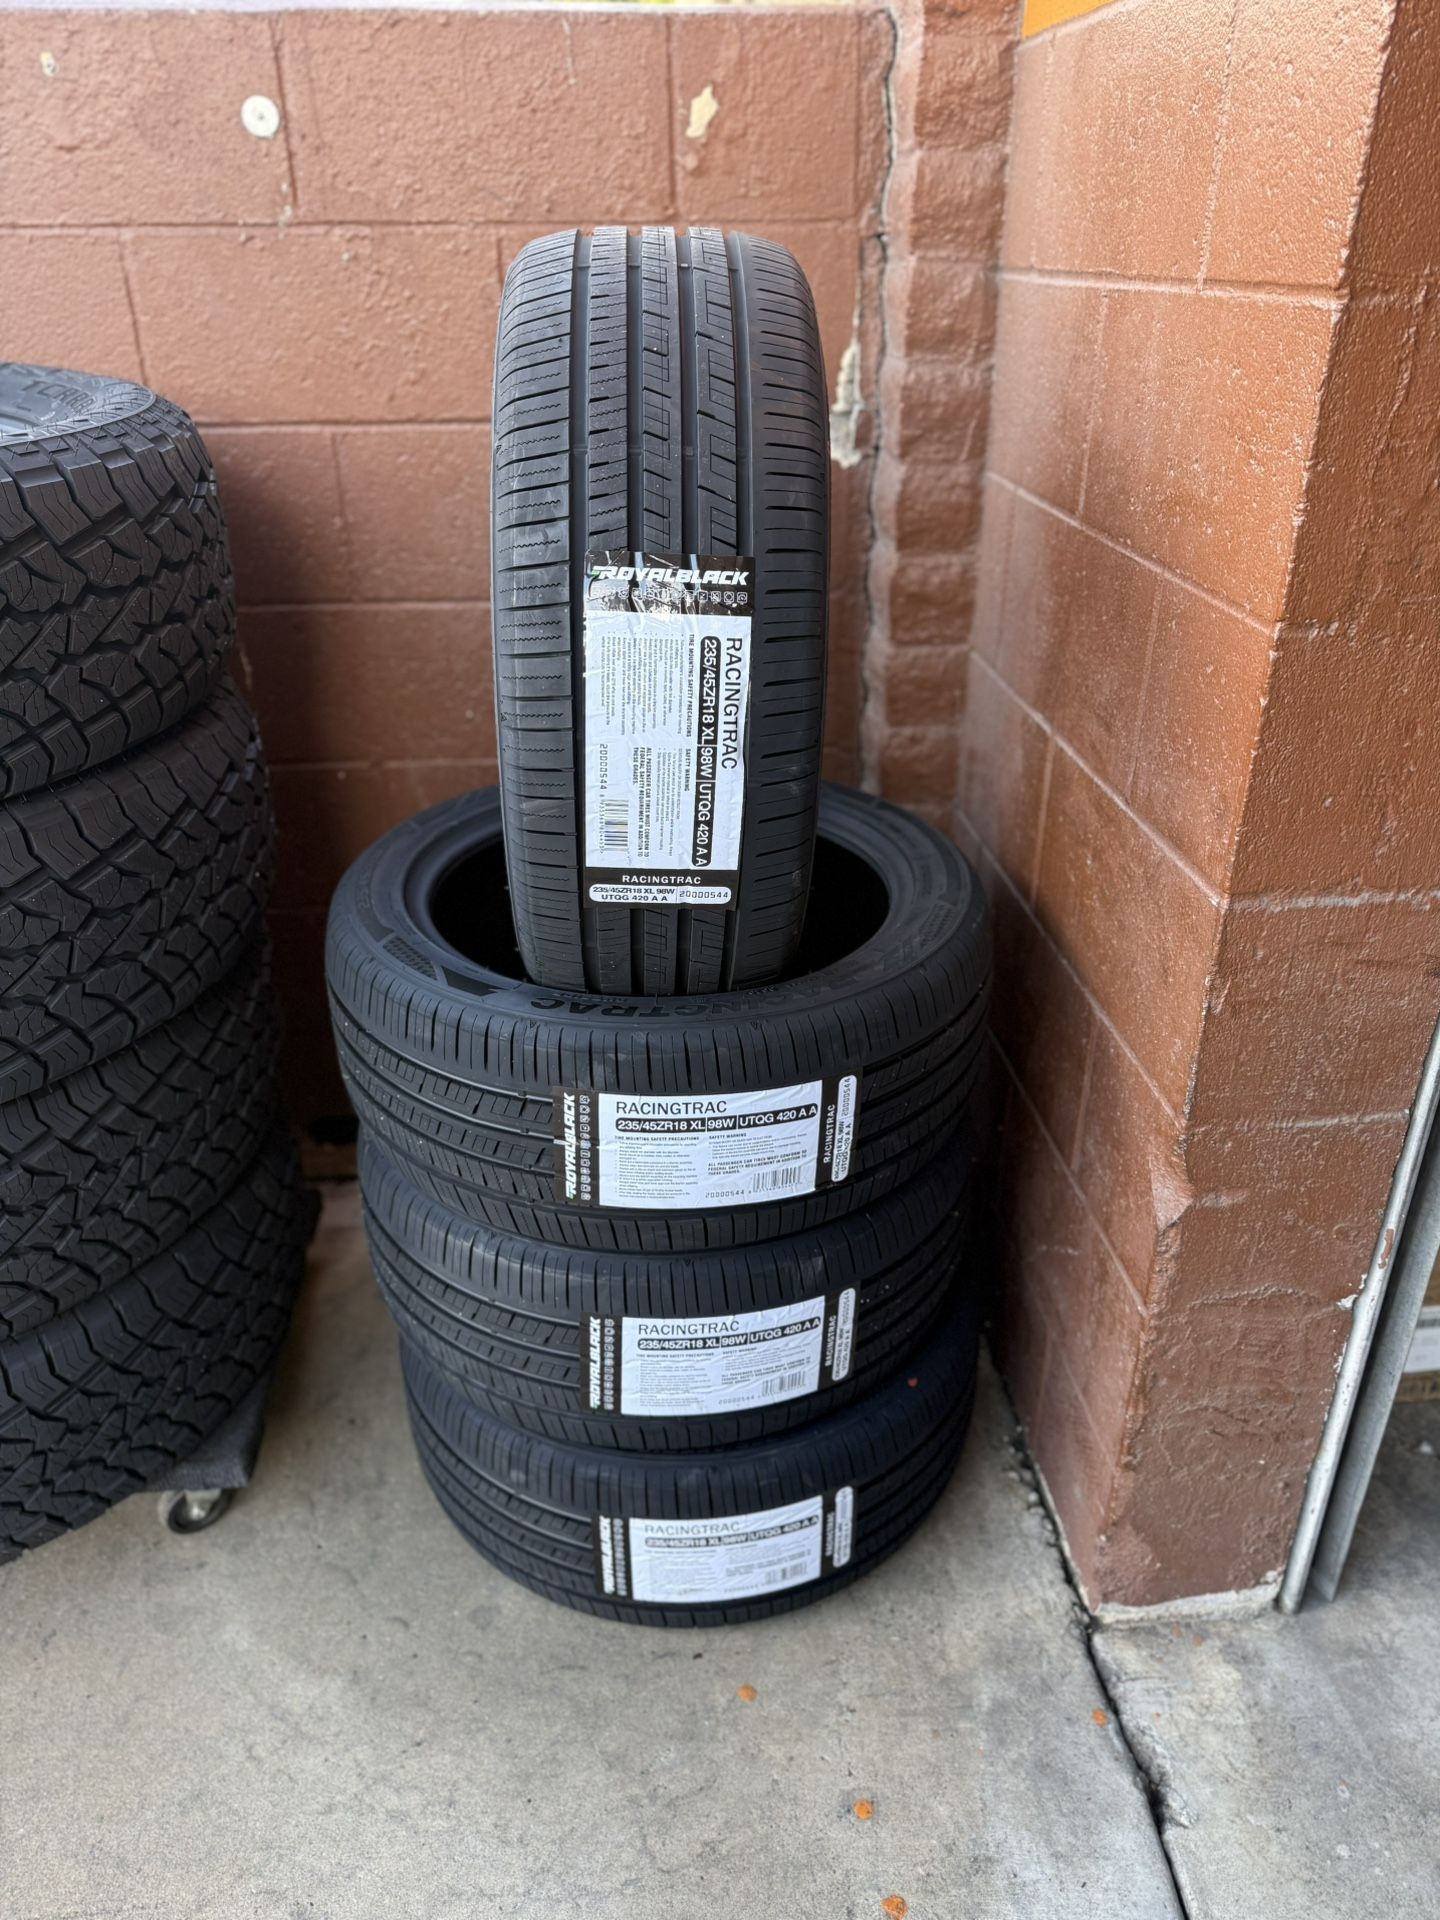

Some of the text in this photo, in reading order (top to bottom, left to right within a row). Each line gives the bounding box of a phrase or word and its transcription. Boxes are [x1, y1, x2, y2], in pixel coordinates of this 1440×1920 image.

[591, 565, 750, 587] ROYALBLACK
[721, 637, 743, 769] RACINGTRAC
[695, 639, 717, 866] 235/45ZR18 XL 98W UTQG 420 A A
[599, 743, 608, 790] 20000544
[593, 886, 643, 895] 235/45ZR18
[622, 875, 701, 884] RACINGTRAC
[679, 890, 728, 899] 20000544
[616, 1100, 727, 1115] RACINGTRAC
[617, 1105, 817, 1131] 235/45ZR18 XL 98W UTQG 420 A A
[823, 1104, 836, 1164] RACINGTRAC
[564, 1092, 577, 1200] ROYALBLACK
[705, 1189, 745, 1198] 20000544
[638, 1320, 740, 1336] RACINGTRAC
[639, 1318, 820, 1349] 235/45ZR18 XL 98W UTQG 420 A A
[644, 1521, 740, 1536] RACINGTRAC
